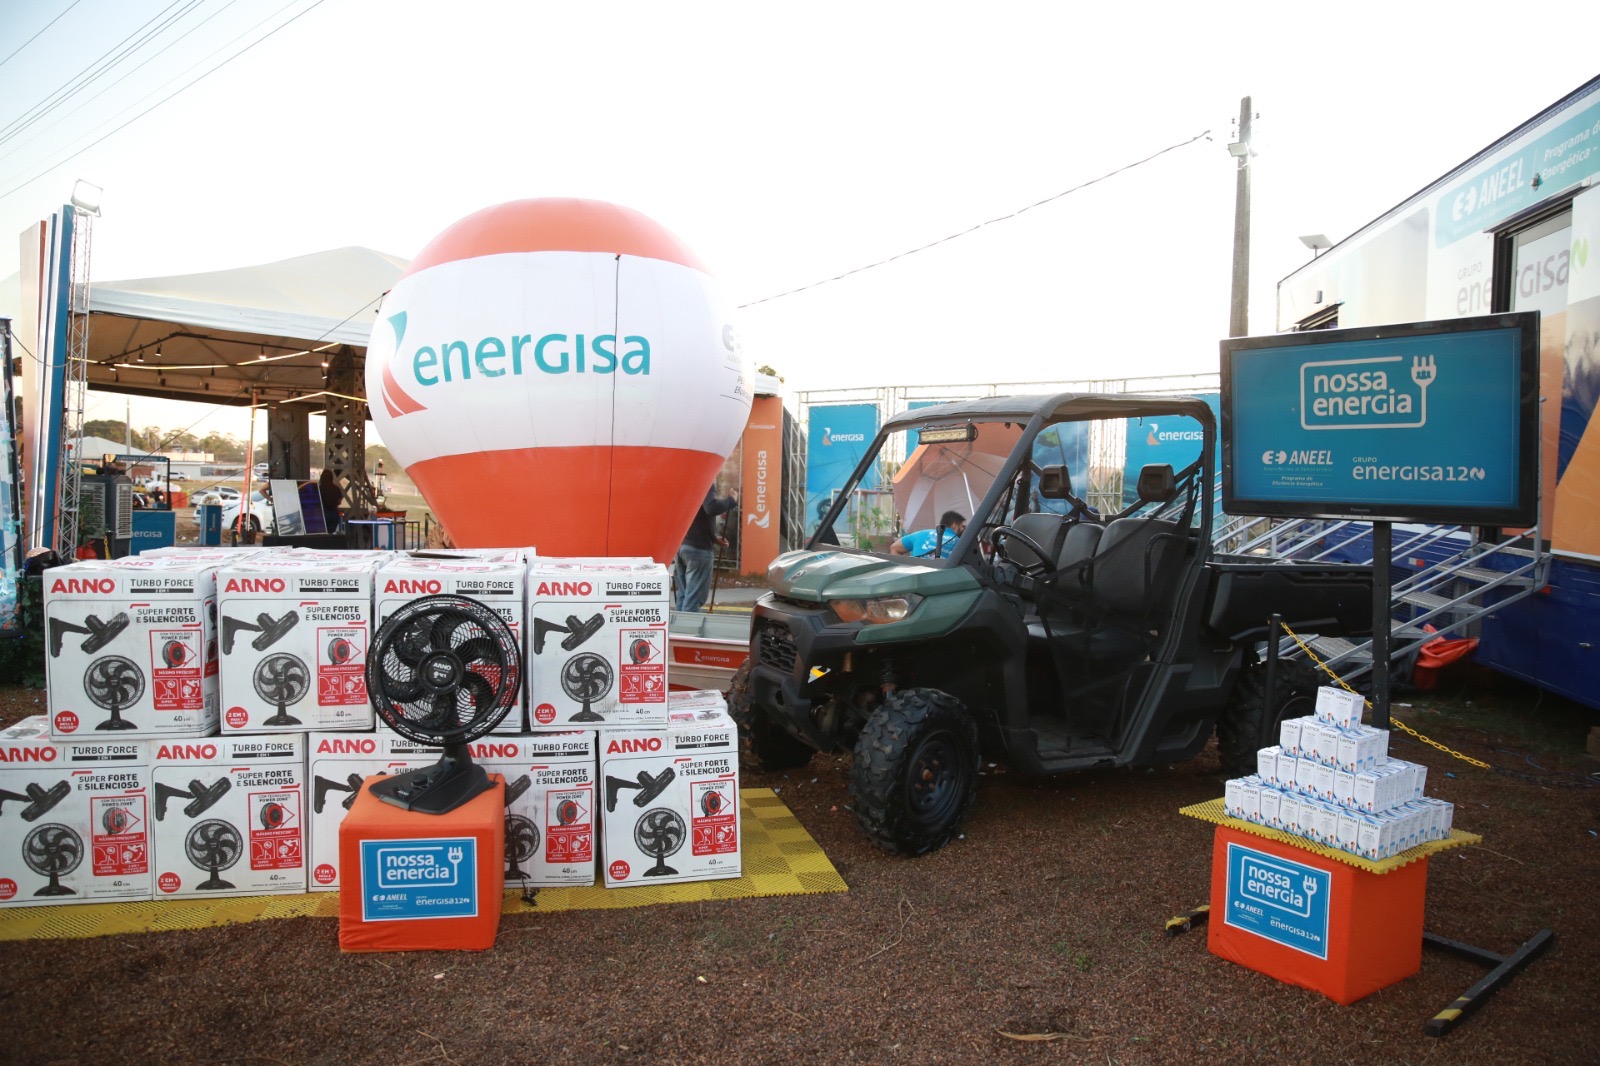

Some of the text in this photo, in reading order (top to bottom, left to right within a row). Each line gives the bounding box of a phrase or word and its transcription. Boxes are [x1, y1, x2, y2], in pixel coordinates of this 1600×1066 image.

[1544, 128, 1590, 162] Programa
[1542, 148, 1590, 178] Energética
[1478, 157, 1524, 209] ANEEL
[1458, 262, 1482, 280] GRUPO
[413, 334, 651, 386] energisa
[1314, 371, 1387, 394] nossa
[1313, 388, 1412, 416] energia
[831, 432, 864, 442] energisa
[1289, 450, 1333, 465] ANEEL
[756, 450, 767, 512] energisa
[51, 578, 115, 594] ARNO
[130, 578, 194, 587] TURBO FORCE
[224, 578, 286, 593] ARNO
[299, 578, 359, 586] TURBO FORCE
[384, 579, 442, 594] ARNO
[536, 582, 592, 596] ARNO
[137, 608, 164, 616] SUPER
[433, 662, 451, 670] ARNO
[72, 746, 138, 754] TURBO FORCE
[156, 744, 217, 759] ARNO
[317, 739, 376, 753] ARNO
[607, 738, 662, 754] ARNO
[265, 770, 292, 778] FORTE
[686, 767, 729, 776] SILENCIOSO
[84, 782, 139, 790] SILENCIOSO
[243, 778, 294, 786] SILENCIOSO
[542, 776, 588, 784] SILENCIOSO
[386, 854, 434, 867] nossa
[386, 864, 450, 880] energia
[1249, 865, 1290, 888] nossa
[1248, 879, 1303, 907] energia
[1246, 905, 1264, 916] ANEEL
